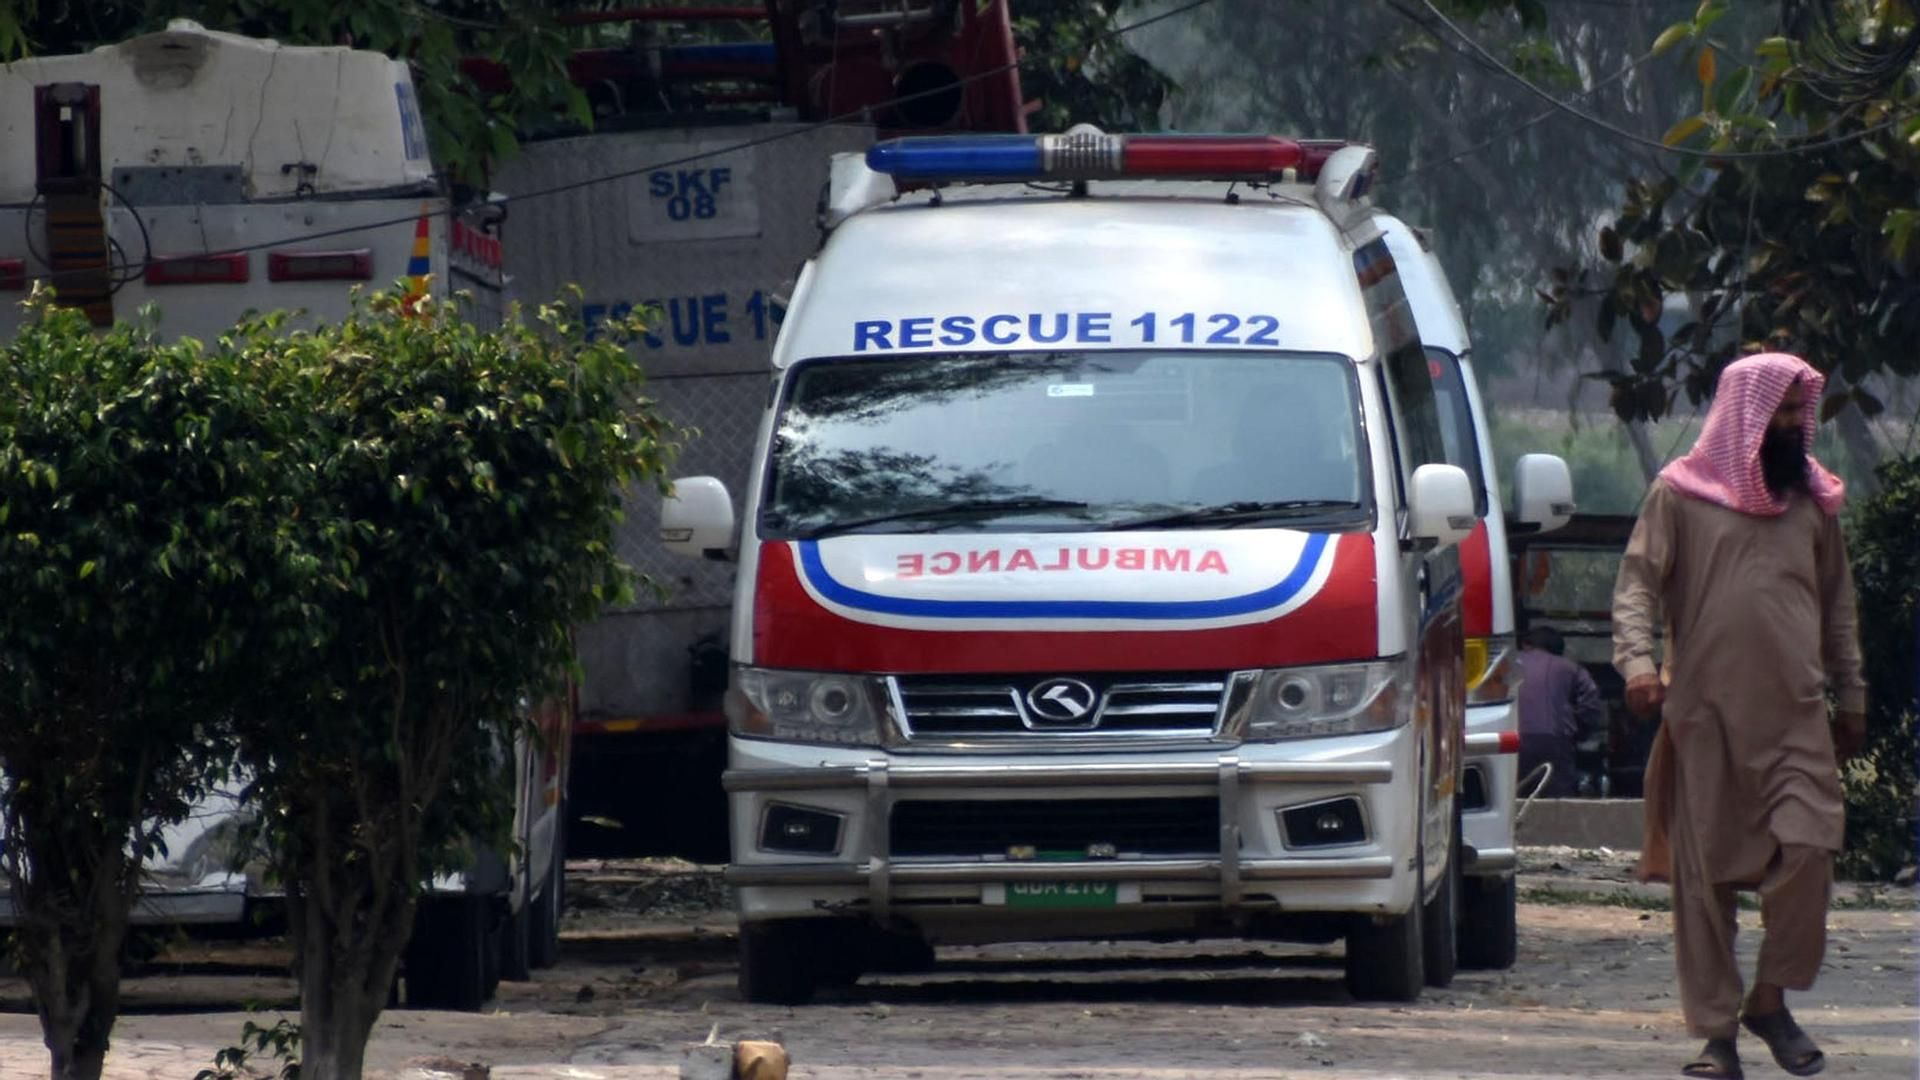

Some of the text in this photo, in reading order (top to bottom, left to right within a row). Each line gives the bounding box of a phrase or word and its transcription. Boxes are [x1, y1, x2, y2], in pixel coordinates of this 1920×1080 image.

[648, 167, 732, 198] SKF
[667, 195, 717, 222] 08
[581, 293, 731, 349] ECUE
[853, 311, 1281, 351] RESCUE 1122
